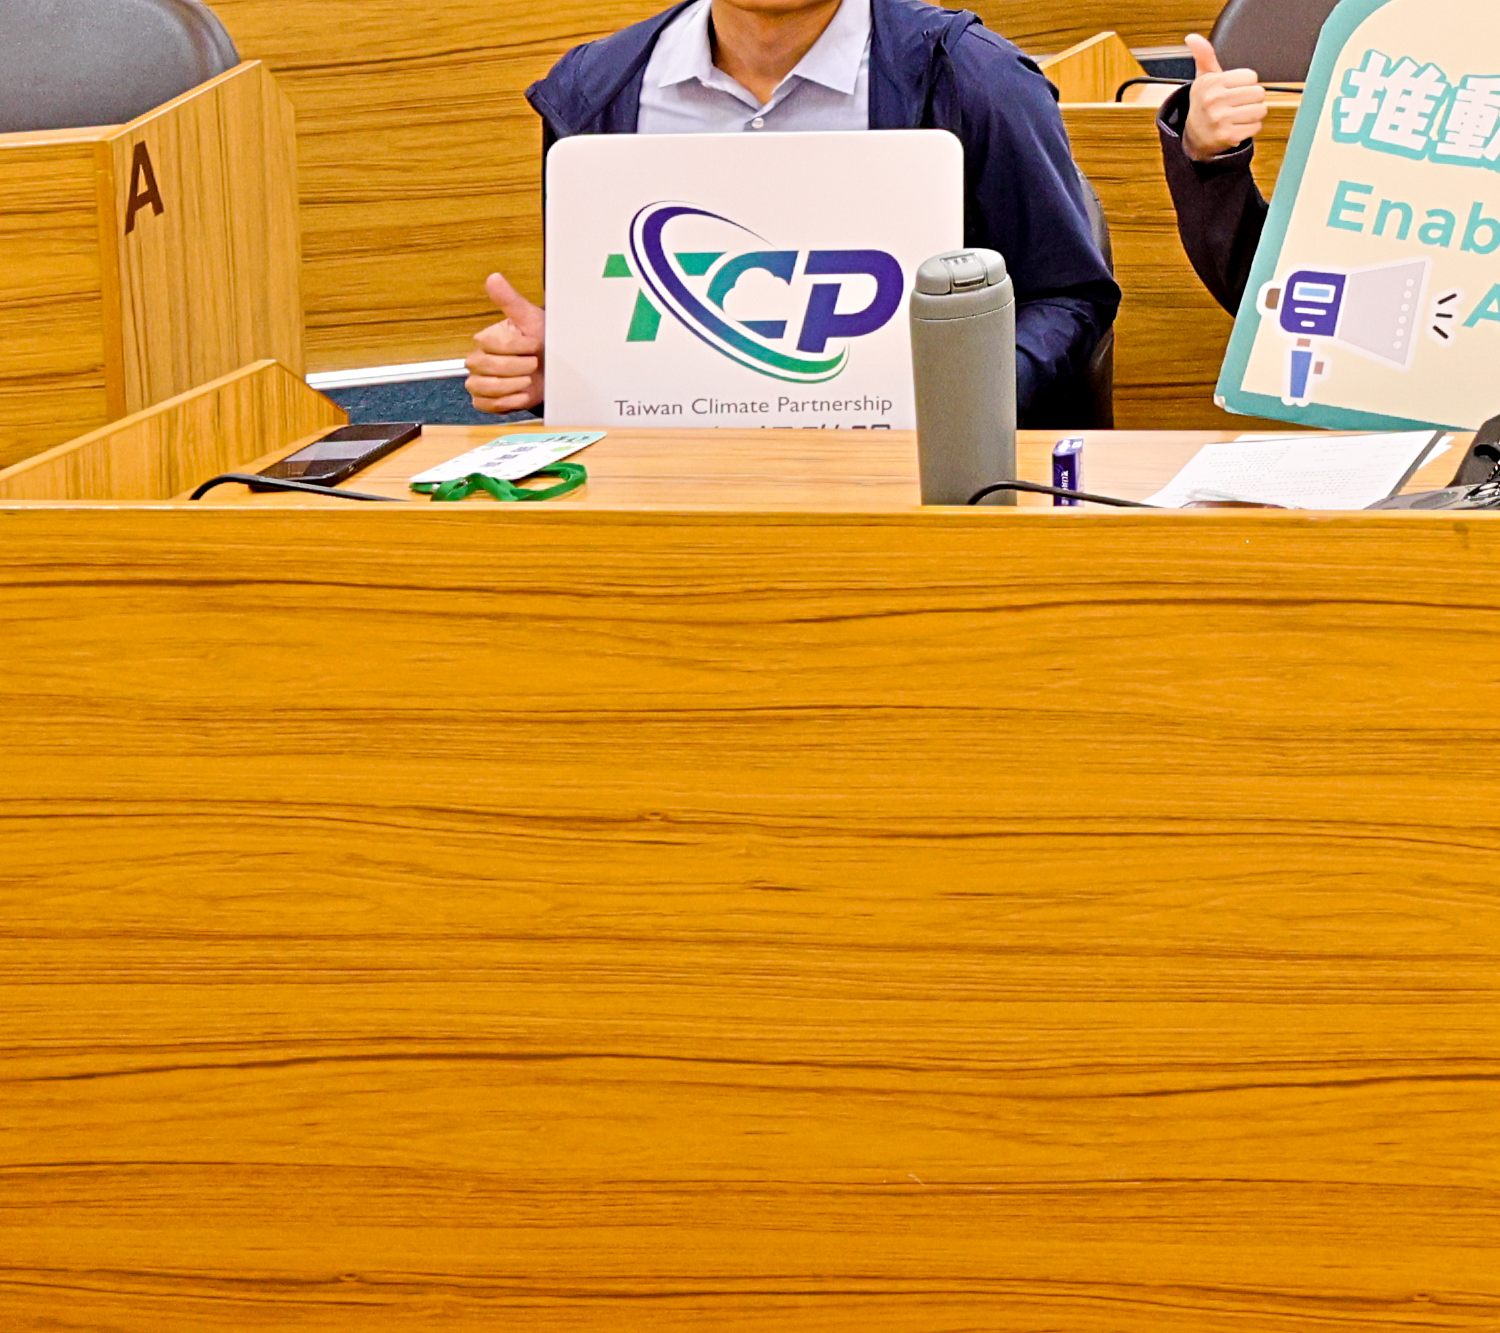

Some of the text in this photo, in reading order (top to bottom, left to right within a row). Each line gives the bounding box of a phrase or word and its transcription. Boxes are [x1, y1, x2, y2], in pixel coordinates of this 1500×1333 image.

[124, 140, 164, 236] A
[602, 248, 905, 354] TCP
[614, 395, 893, 417] Taiwan Climate Partnership
